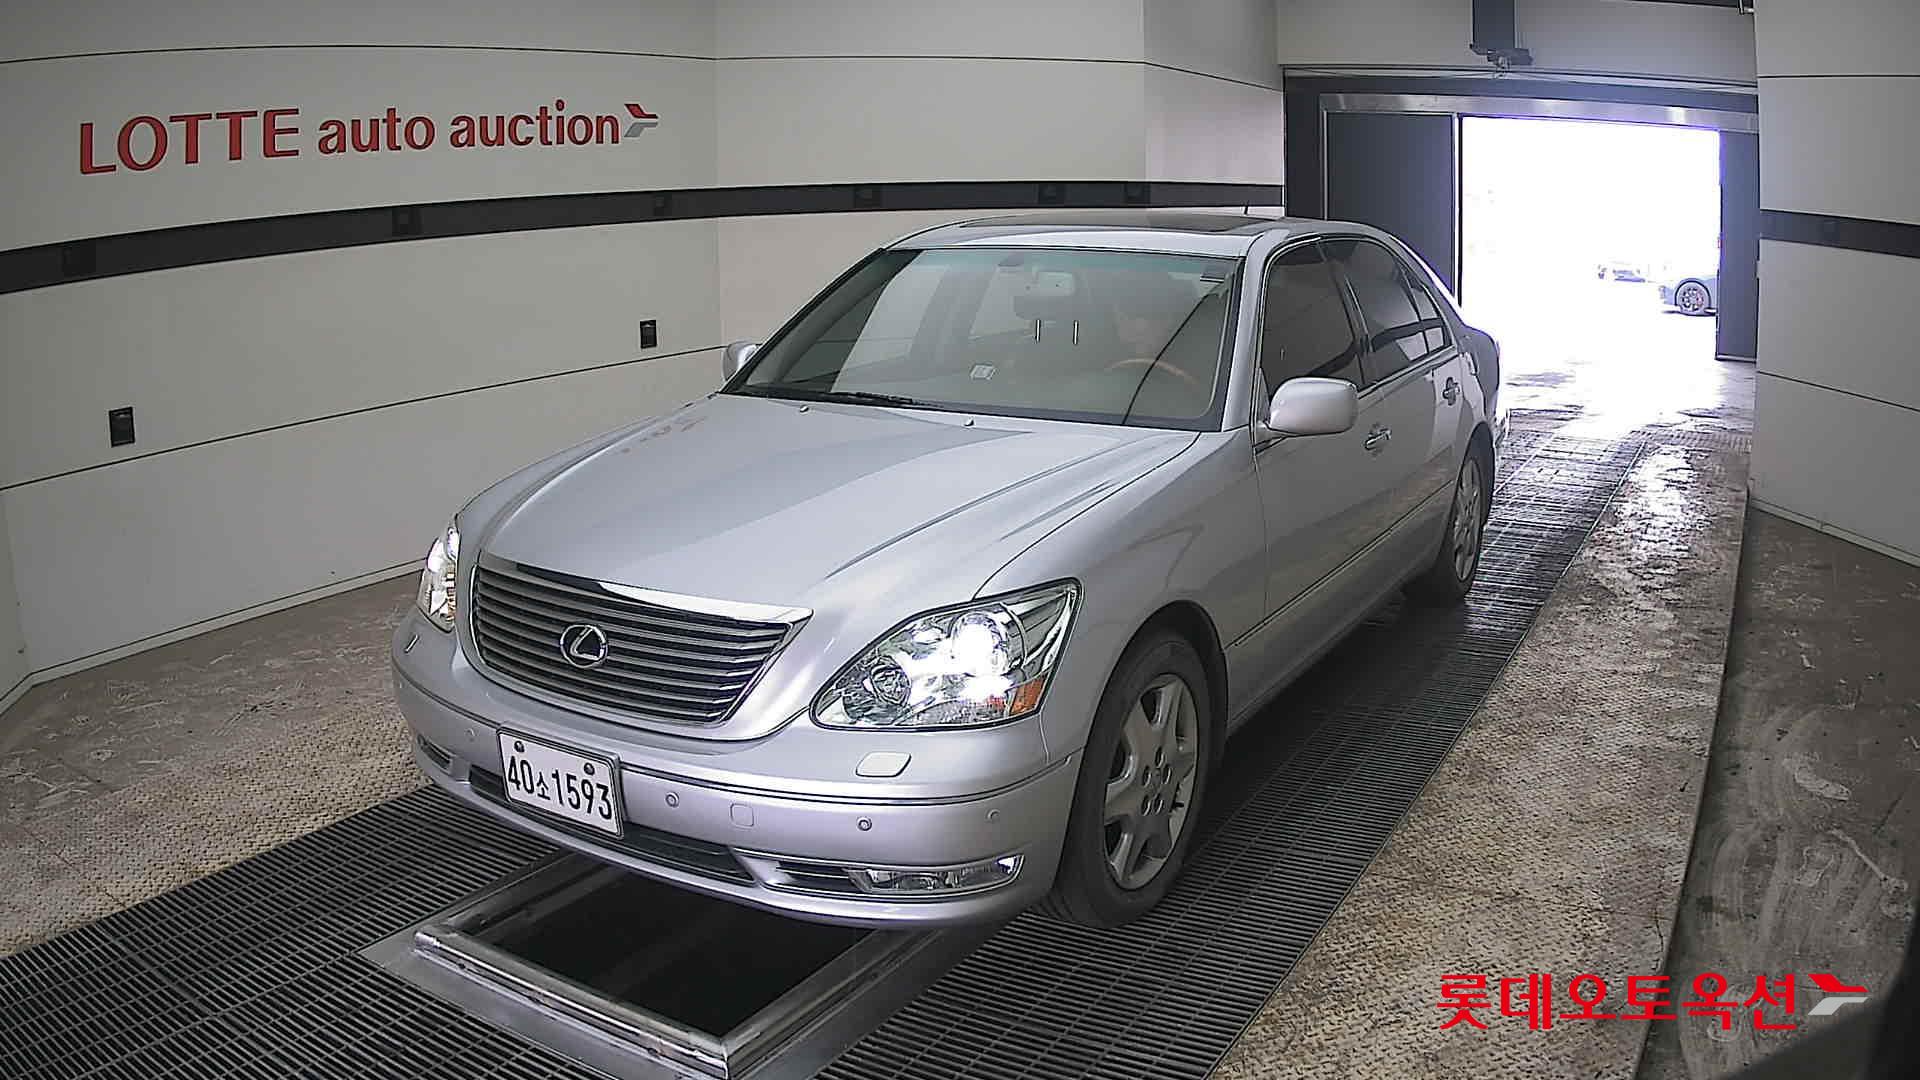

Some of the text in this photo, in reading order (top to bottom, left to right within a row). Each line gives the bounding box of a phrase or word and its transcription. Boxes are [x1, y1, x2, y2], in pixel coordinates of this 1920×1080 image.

[80, 99, 621, 175] LOTTE auto auction
[508, 755, 613, 820] 40소1593
